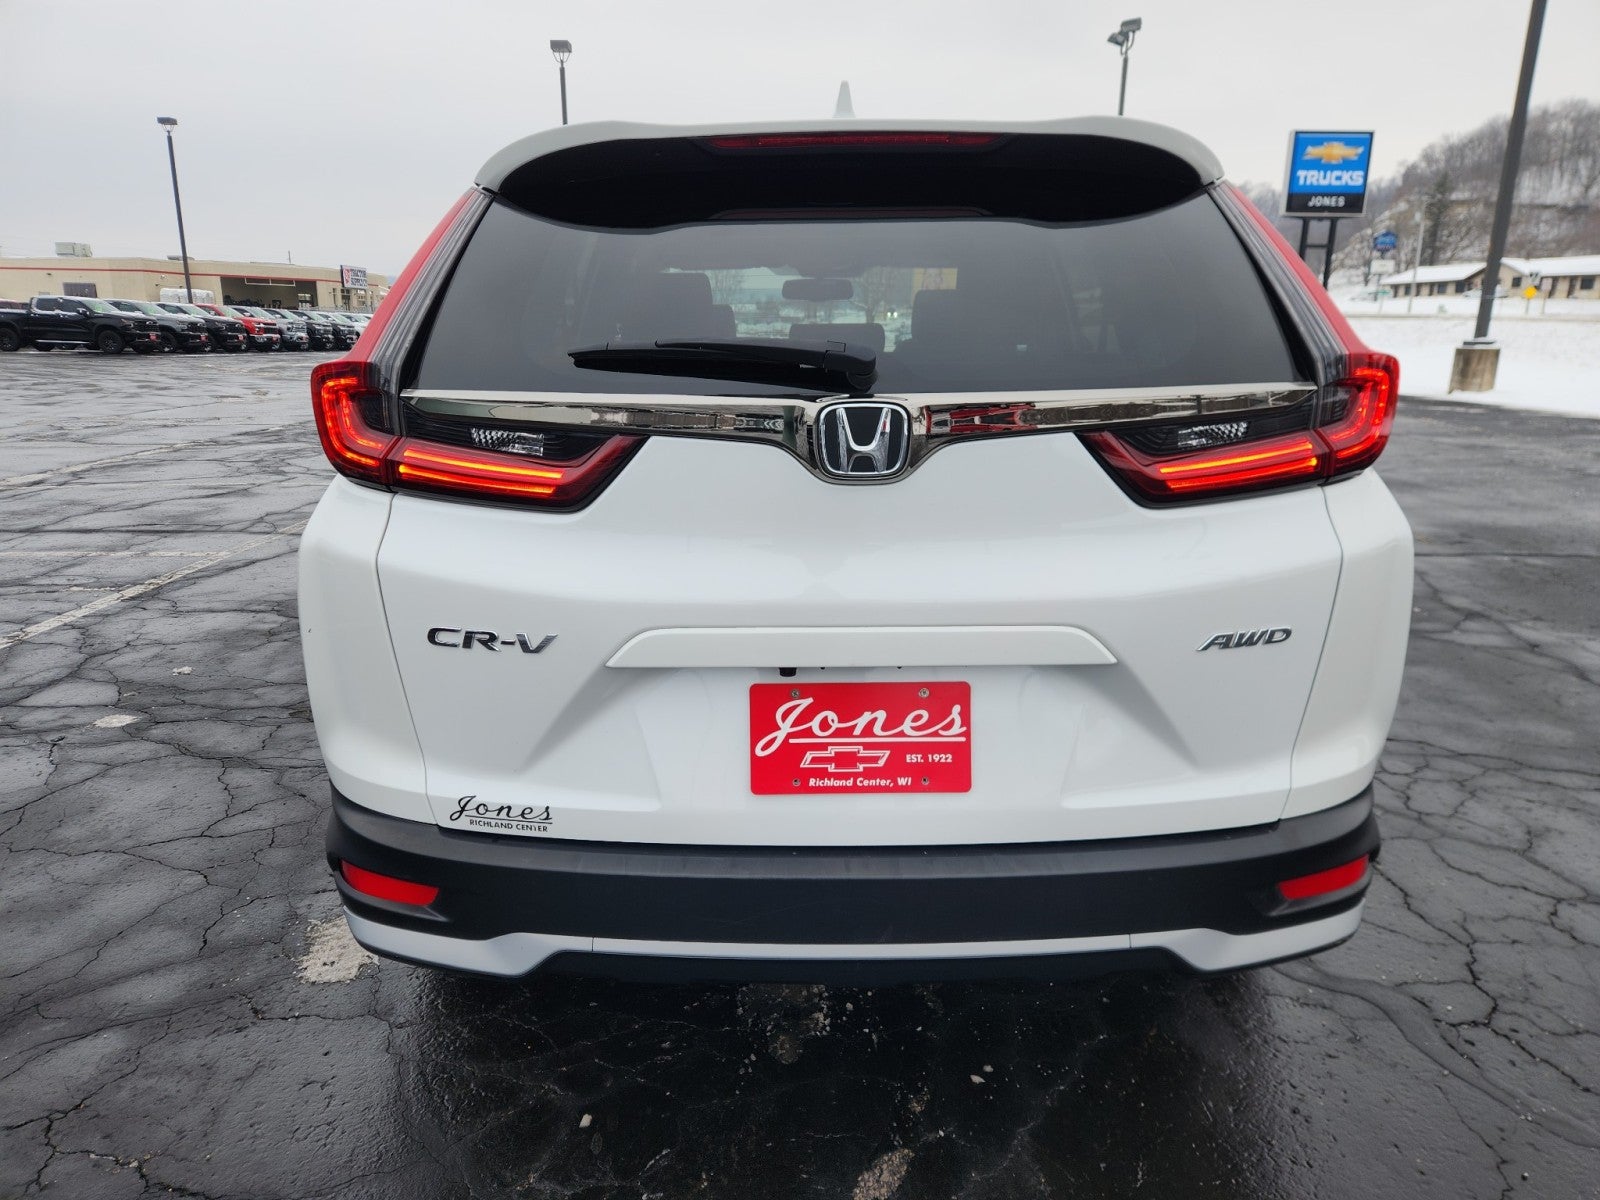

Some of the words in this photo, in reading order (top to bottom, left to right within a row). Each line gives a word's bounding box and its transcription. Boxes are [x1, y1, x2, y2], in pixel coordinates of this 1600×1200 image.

[1297, 169, 1364, 186] TRUCKS
[1307, 195, 1346, 207] JONES
[427, 627, 558, 653] CR-V
[1196, 626, 1292, 651] AWD
[754, 697, 967, 757] Jones
[906, 753, 924, 763] EST.
[928, 753, 953, 763] 1922
[809, 777, 853, 787] Richland
[856, 777, 894, 787] Center,
[897, 777, 912, 786] WI
[449, 795, 552, 821] Jones
[469, 819, 513, 829] RICHLAND
[515, 823, 548, 832] CENTER
